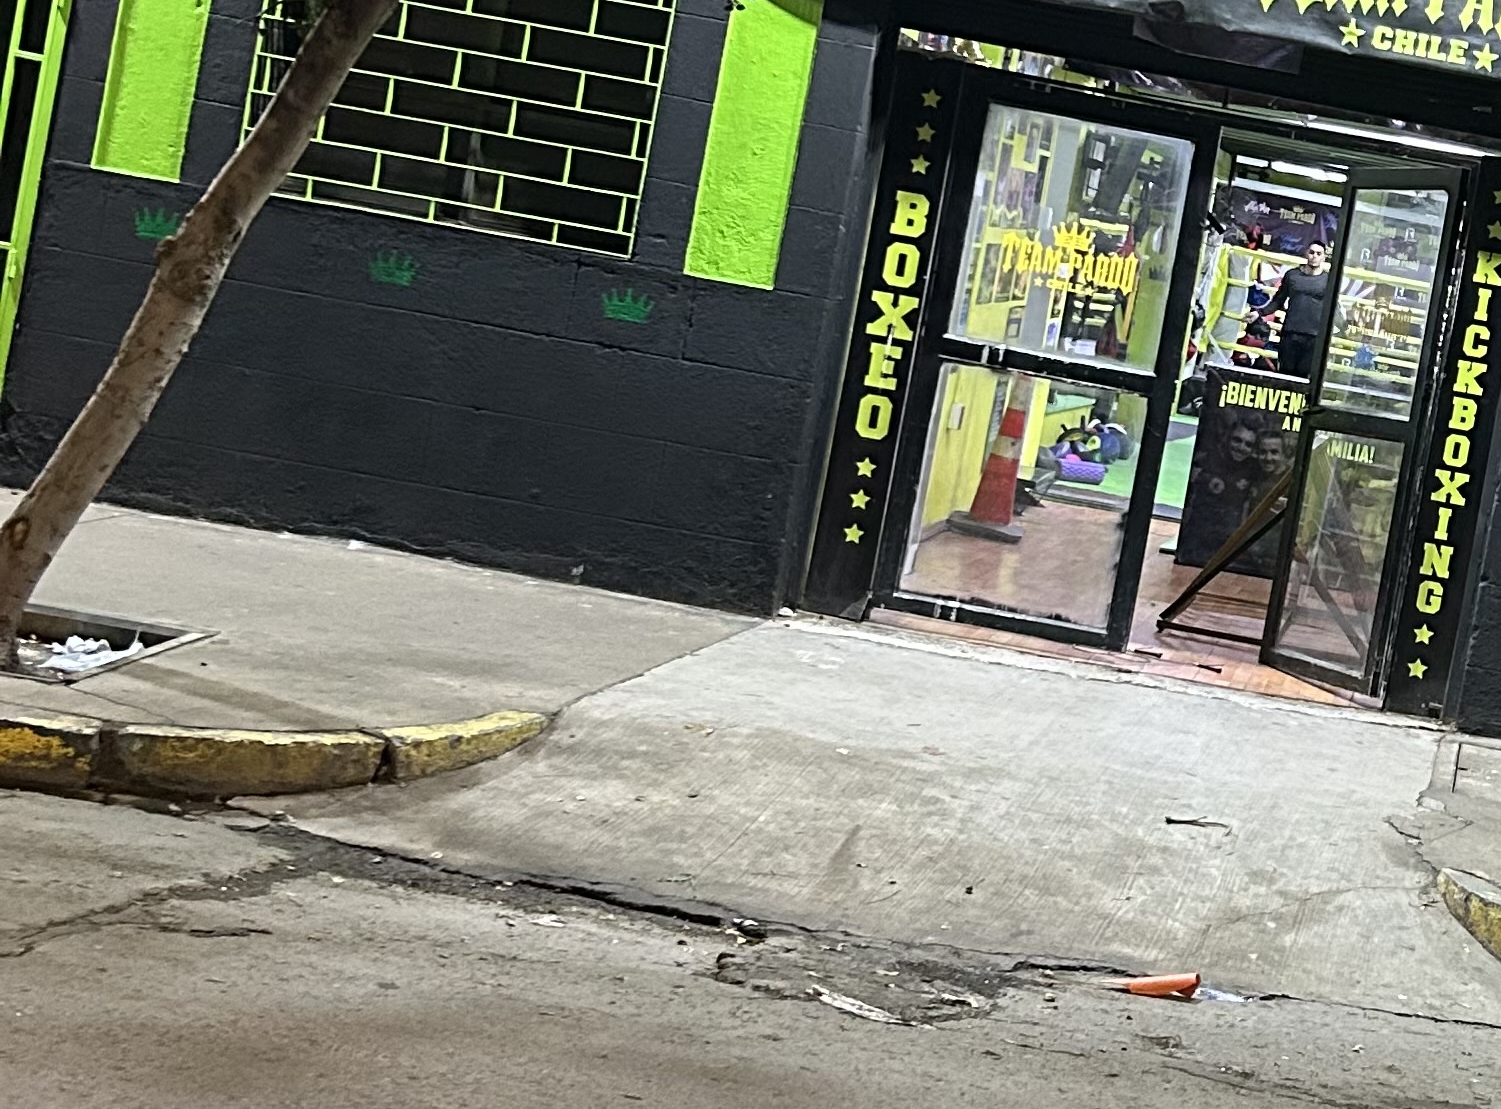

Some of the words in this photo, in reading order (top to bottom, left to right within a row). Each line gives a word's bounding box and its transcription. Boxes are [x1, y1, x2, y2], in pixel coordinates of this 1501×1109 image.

[1371, 25, 1469, 65] CHILE
[1002, 232, 1062, 274] TEAM
[1066, 250, 1138, 296] PARDO
[855, 190, 930, 441] BOXEO
[1218, 381, 1306, 415] ¡BIENVEN
[1282, 415, 1291, 431] A
[1327, 438, 1376, 464] MILIA!
